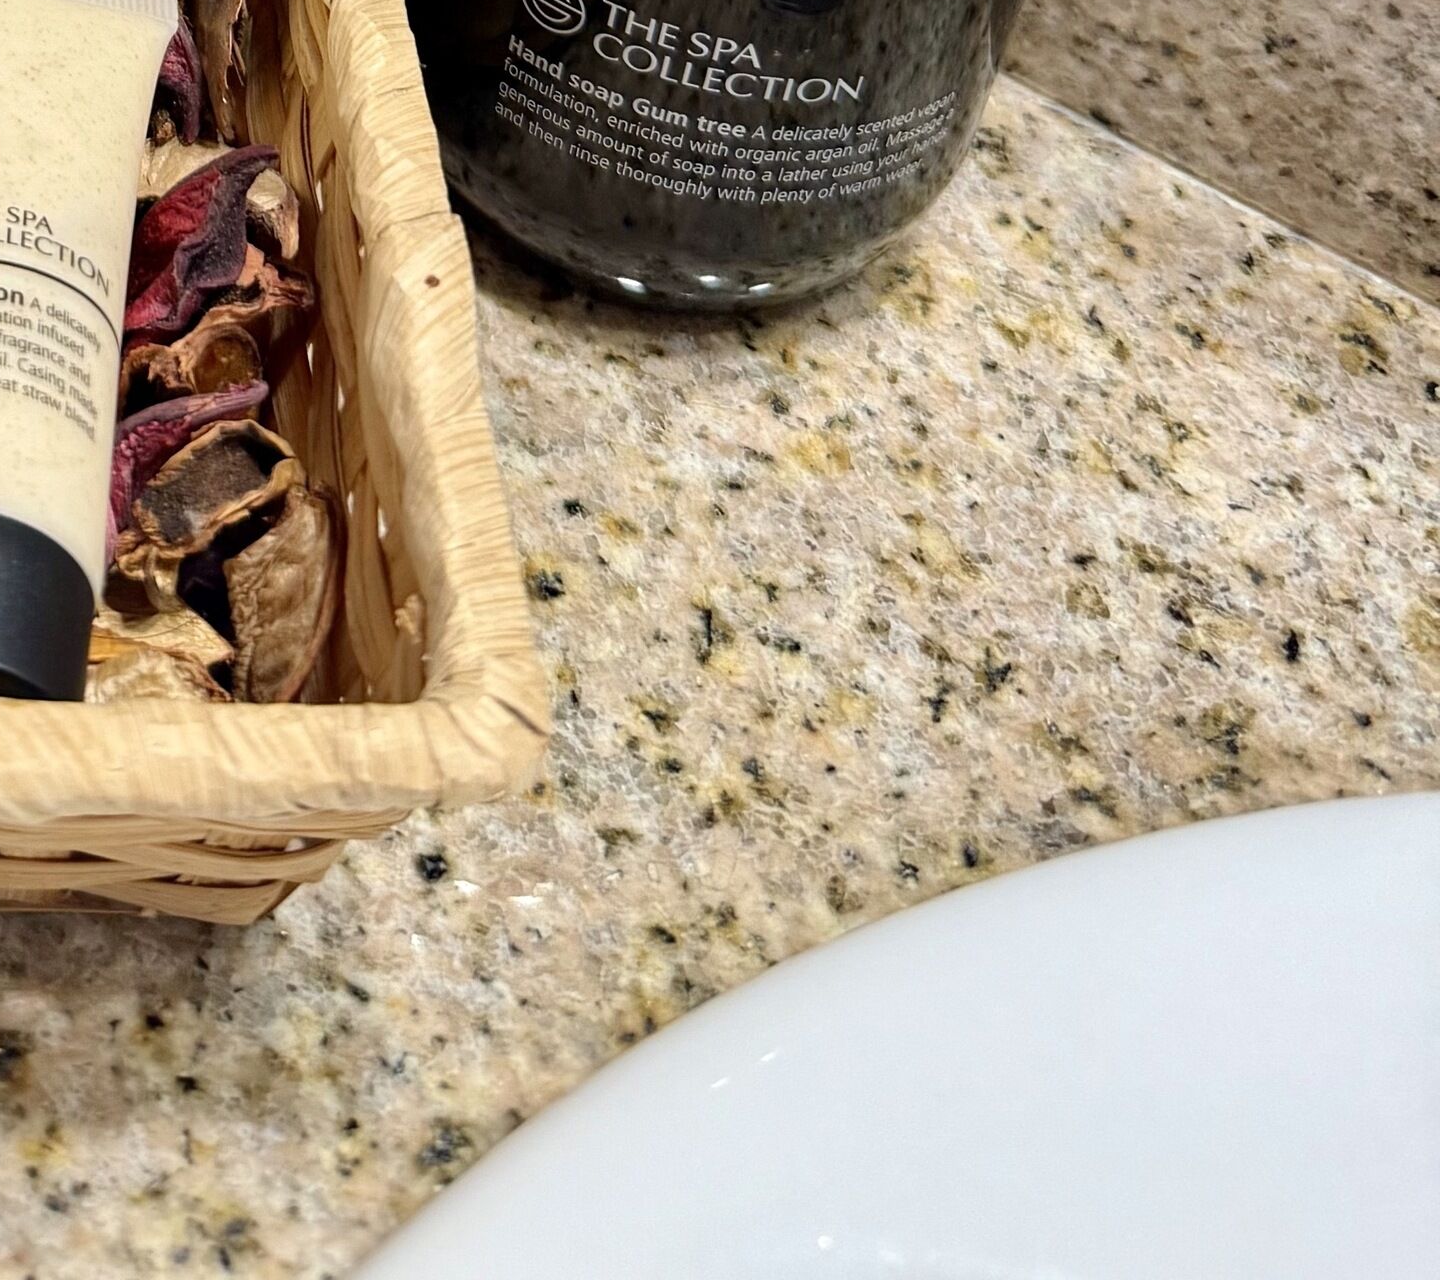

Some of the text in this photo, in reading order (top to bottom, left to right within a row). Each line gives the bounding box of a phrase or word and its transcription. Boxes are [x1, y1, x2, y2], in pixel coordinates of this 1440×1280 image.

[593, 32, 864, 103] COLLECTION
[687, 32, 761, 69] SPA
[504, 57, 954, 164] formulation, enriched with organic argan oil. Massage a
[508, 34, 957, 141] Hand soap Gum tree A delicately scented vegan
[495, 102, 523, 127] and
[528, 121, 564, 150] then
[570, 143, 610, 169] rinse
[616, 161, 712, 200] thoroughly
[718, 187, 755, 201] with
[761, 187, 813, 204] plenty
[818, 183, 837, 199] of
[840, 176, 881, 195] warm
[499, 81, 570, 130] generous
[576, 124, 644, 159] amount
[649, 151, 670, 166] of
[672, 157, 716, 178] soap
[721, 164, 756, 181] into
[761, 170, 772, 181] a
[778, 167, 827, 182] lather
[832, 159, 873, 178] using
[876, 148, 908, 172] your
[6, 206, 53, 235] SPA
[30, 297, 42, 312] A
[46, 303, 101, 354] delicately
[37, 319, 84, 358] infused
[17, 357, 65, 394] Casing
[22, 384, 61, 411] straw
[69, 362, 91, 387] and
